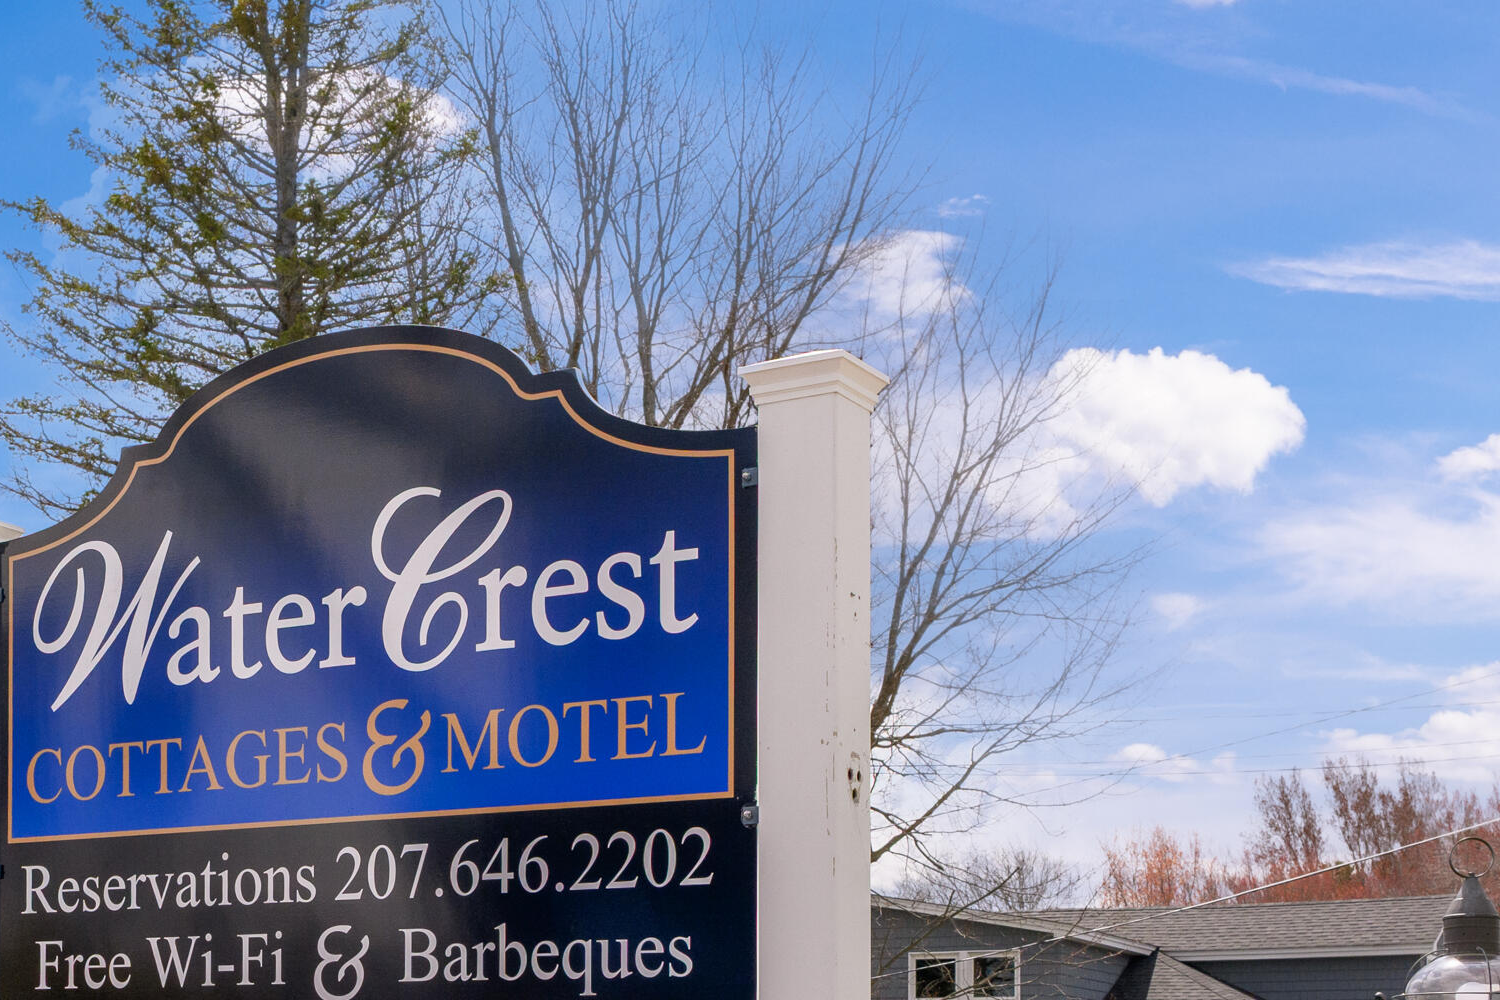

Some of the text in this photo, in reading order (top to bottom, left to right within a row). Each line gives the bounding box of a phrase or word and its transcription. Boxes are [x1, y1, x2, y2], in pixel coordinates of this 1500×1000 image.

[26, 692, 707, 804] COTTAGES & MOTEL
[20, 826, 714, 915] Reservations 207.646.2202
[34, 940, 132, 990] Free
[146, 931, 286, 989] Wi-Fi
[397, 923, 693, 997] Barbeques
